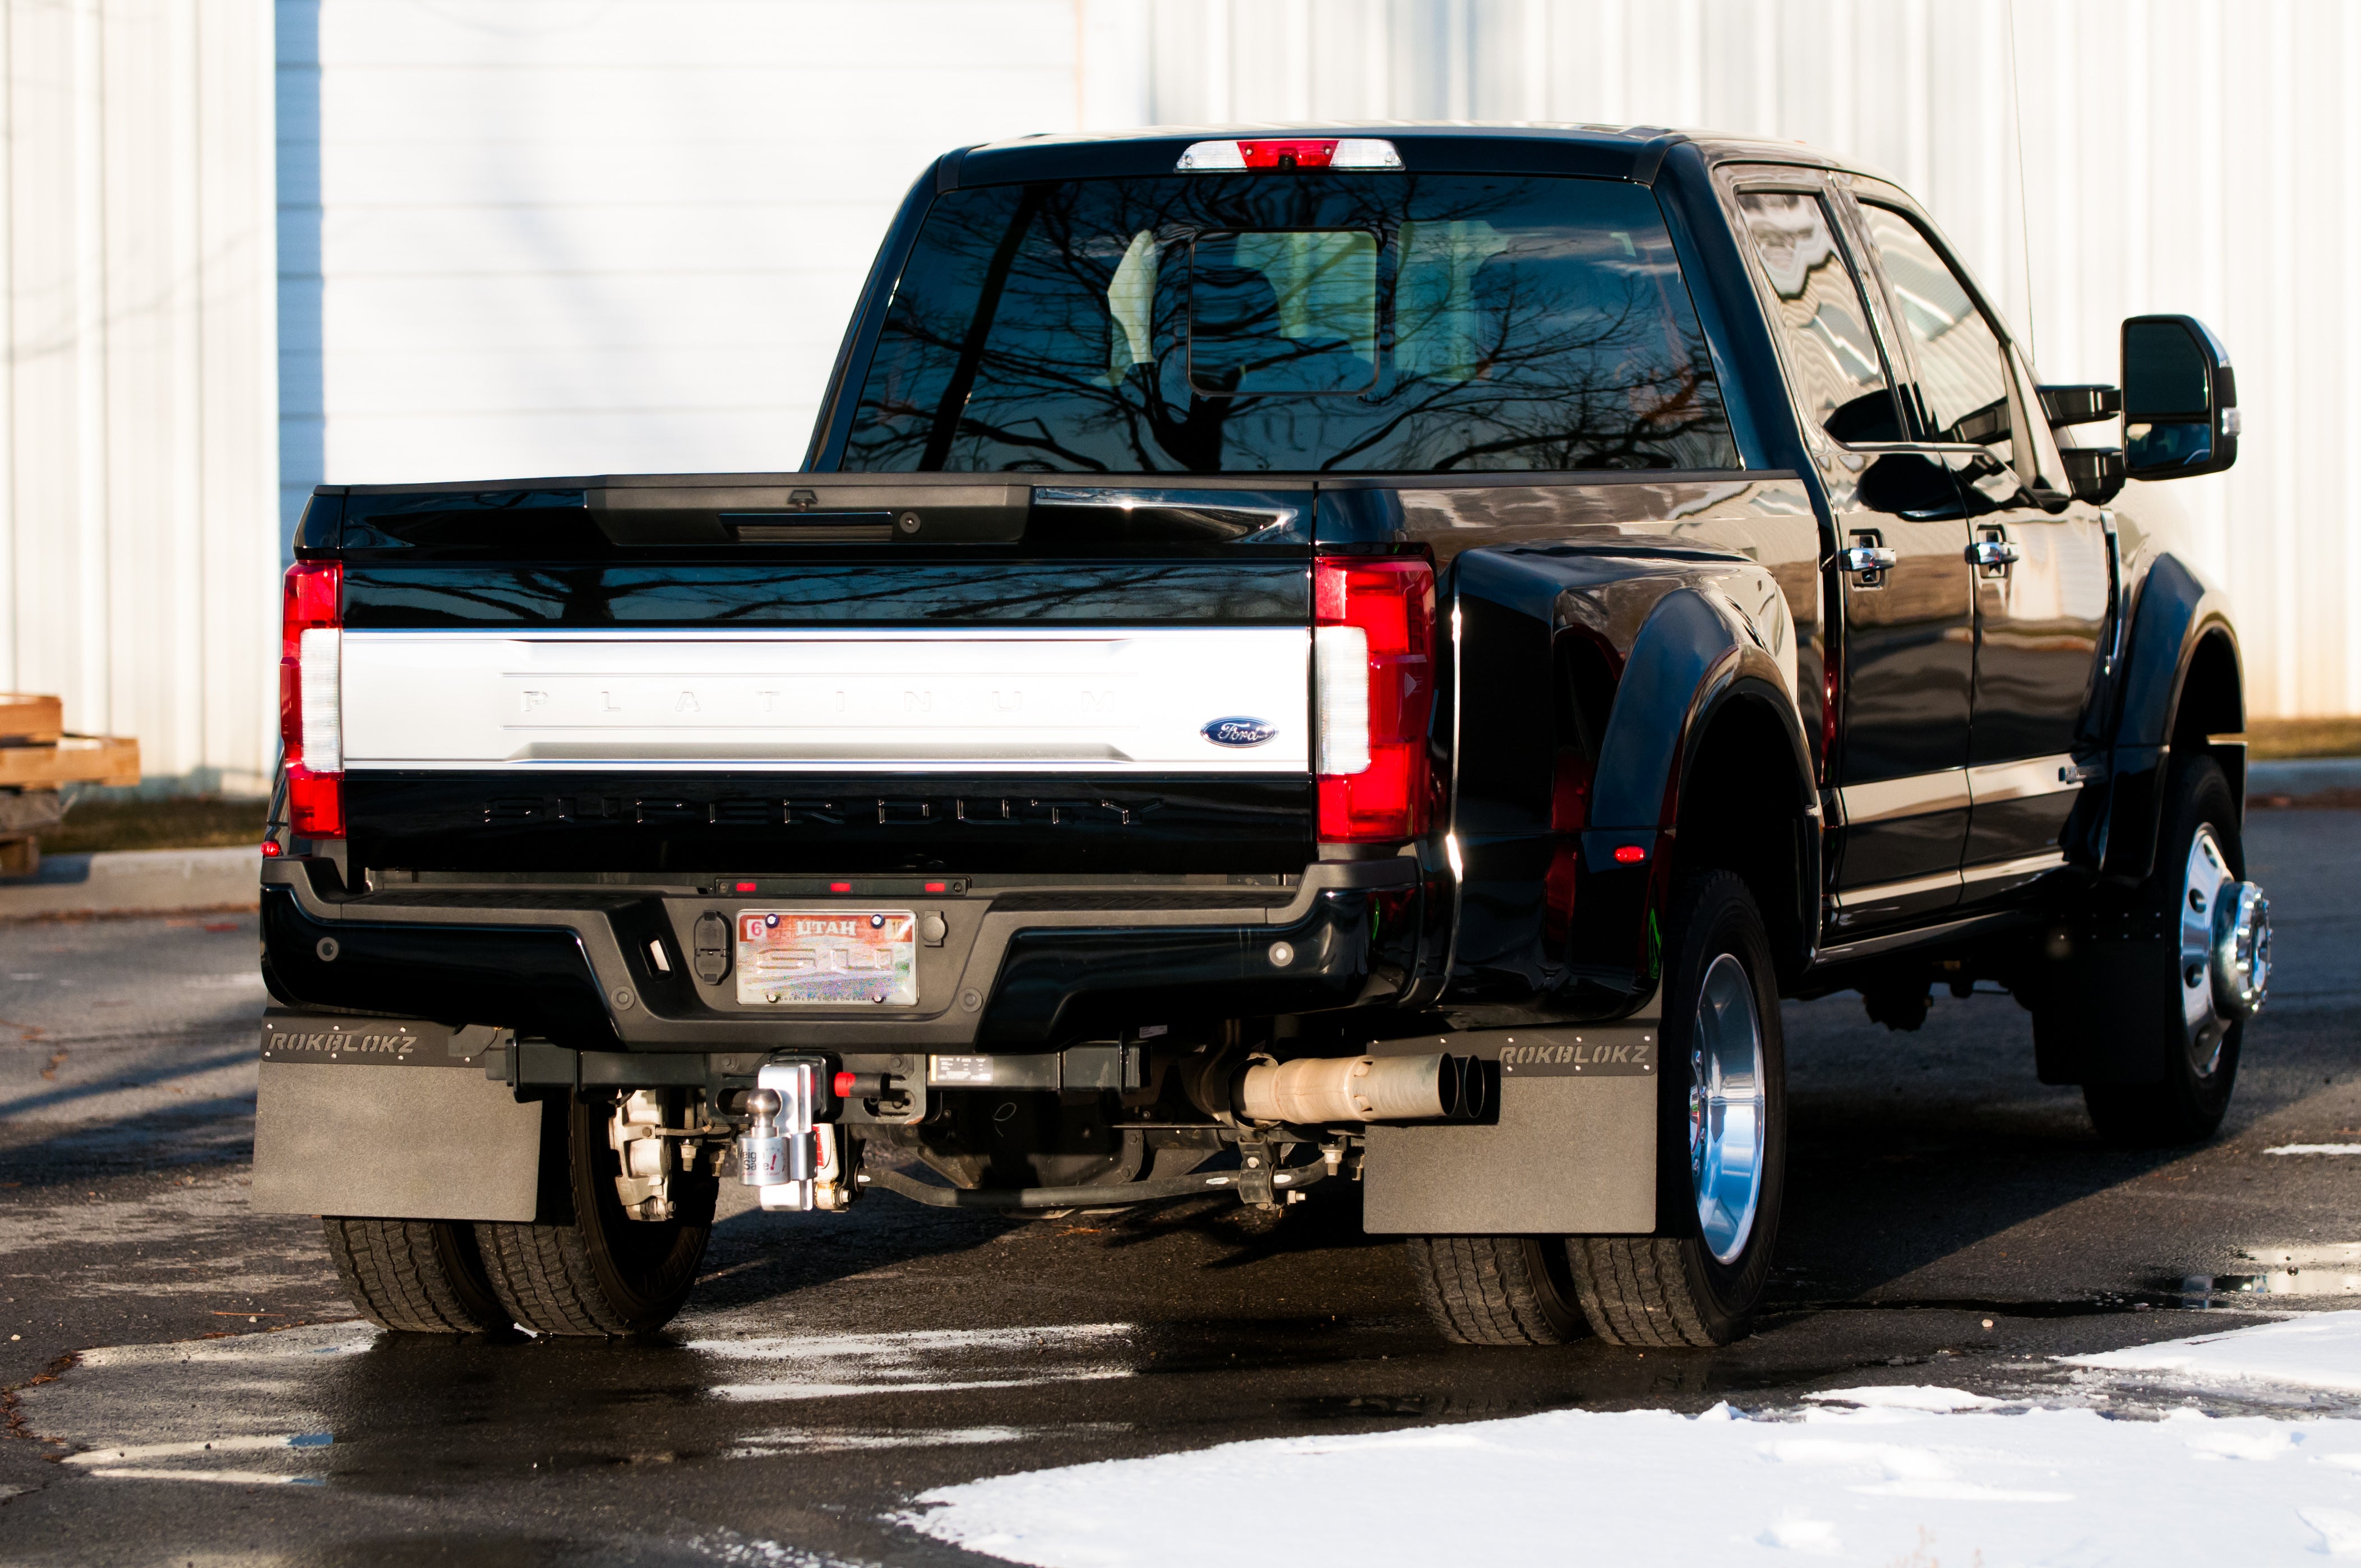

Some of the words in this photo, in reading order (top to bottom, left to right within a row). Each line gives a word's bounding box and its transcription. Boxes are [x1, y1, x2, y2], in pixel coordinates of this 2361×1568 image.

[521, 690, 1115, 713] PLATINUM
[1217, 723, 1267, 741] Ford
[484, 796, 847, 825] SUPER
[877, 797, 1164, 826] DUTY
[751, 921, 763, 937] 6
[796, 921, 856, 936] UTAH
[267, 1032, 417, 1053] ROKBLOKZ
[1498, 1045, 1650, 1064] ROKBLOKZ
